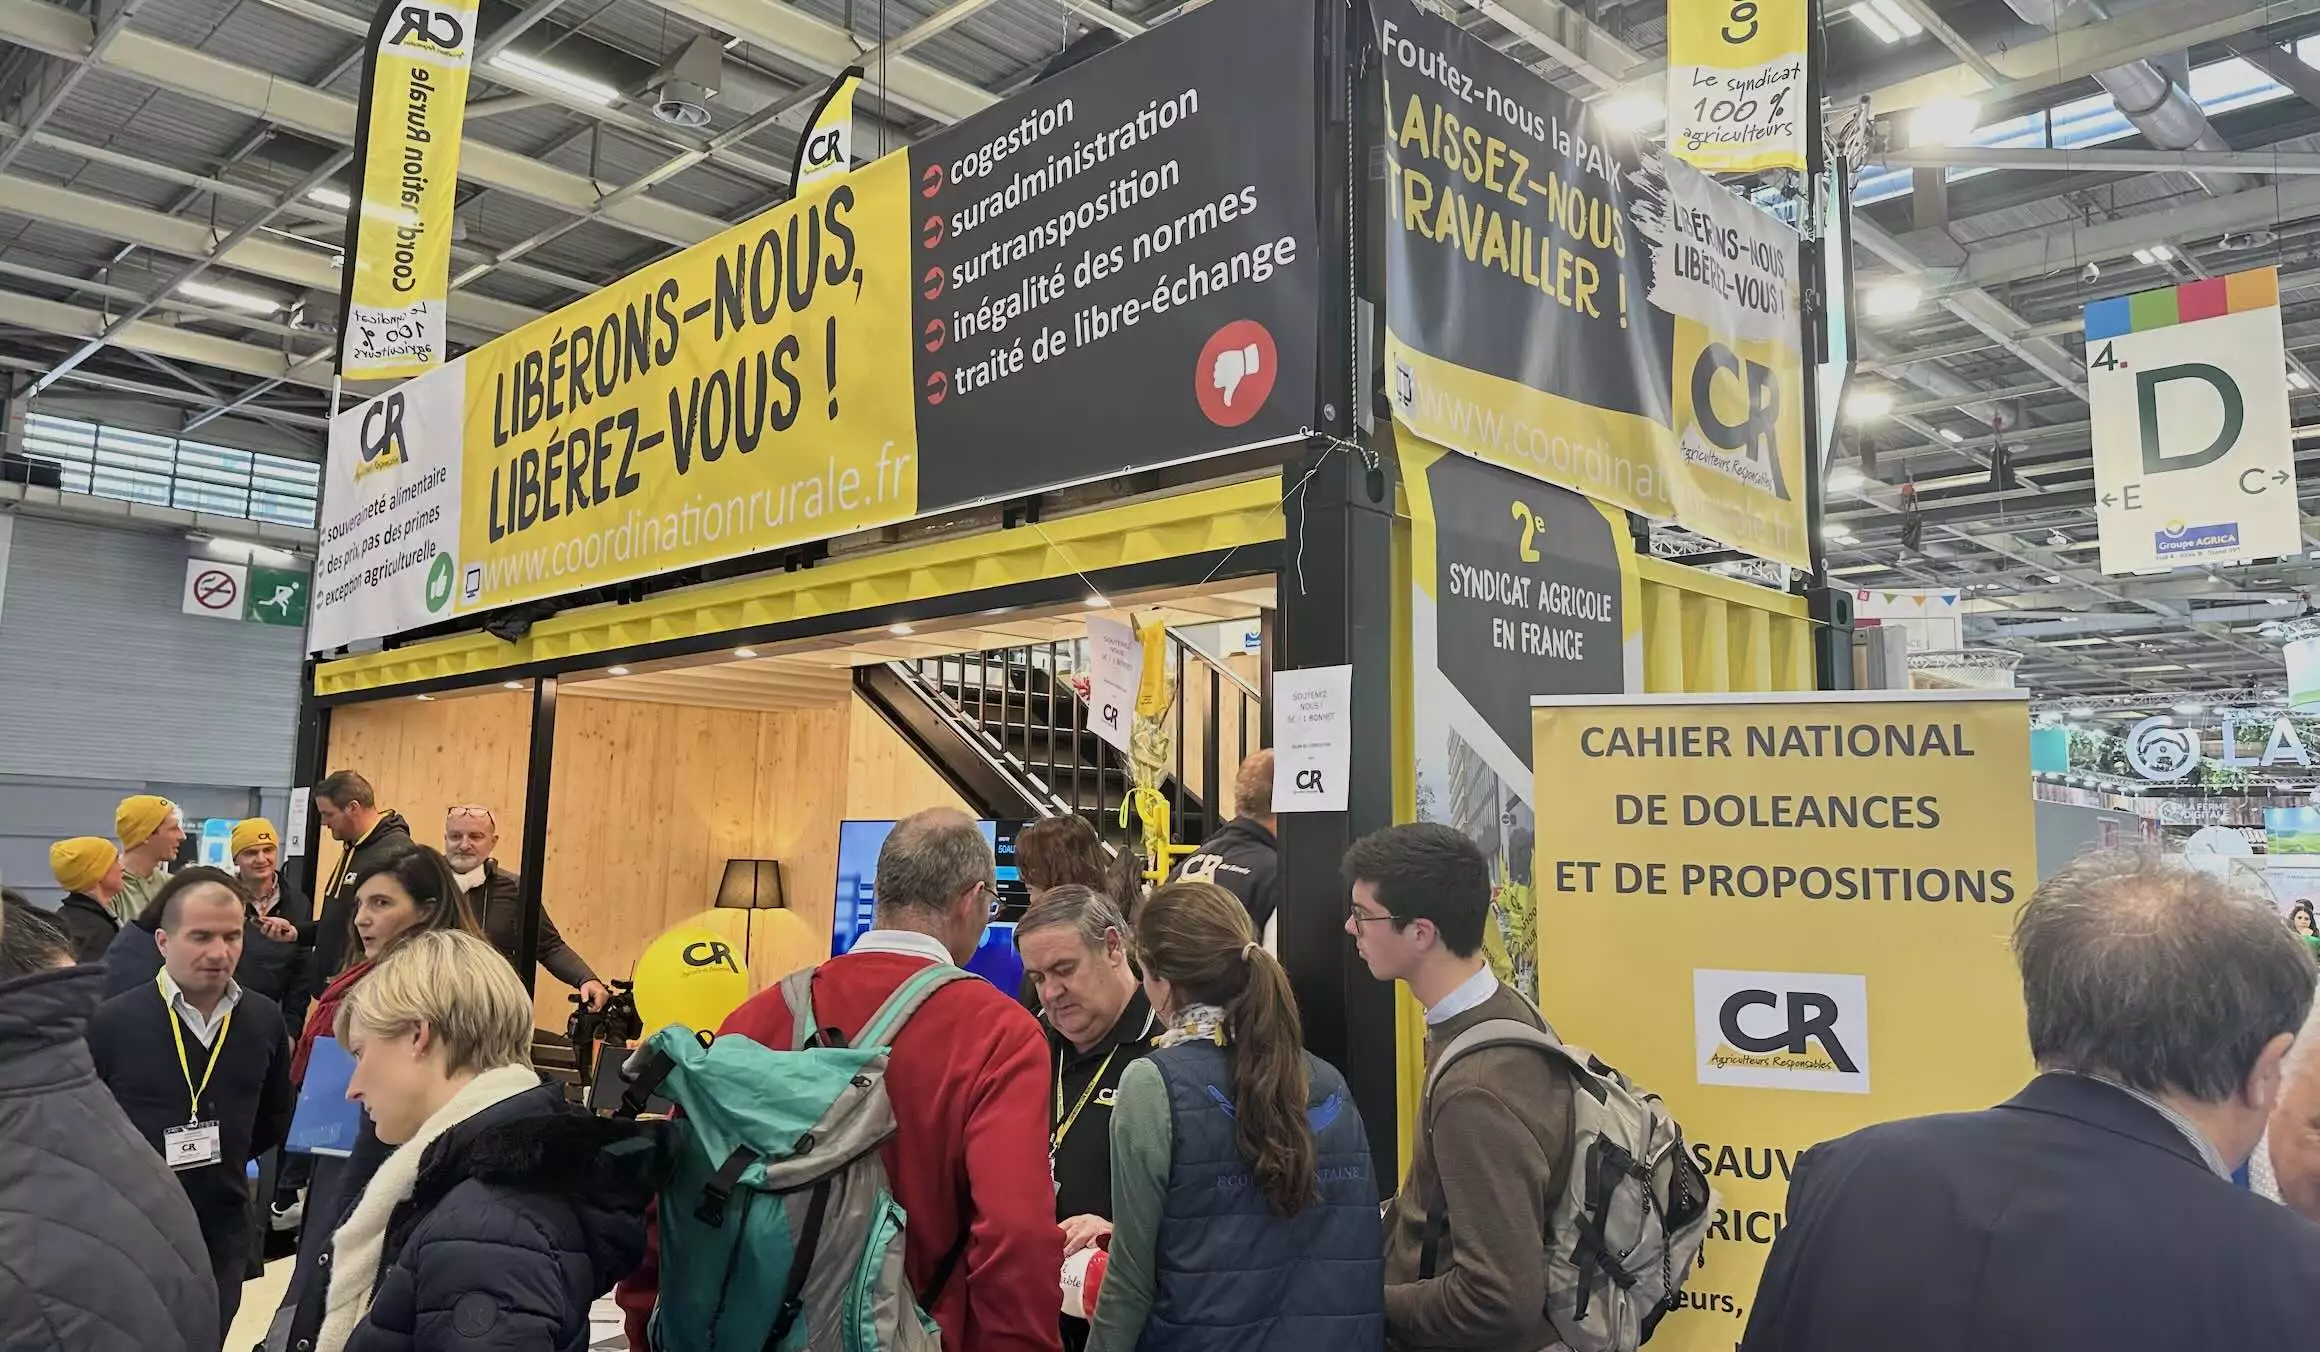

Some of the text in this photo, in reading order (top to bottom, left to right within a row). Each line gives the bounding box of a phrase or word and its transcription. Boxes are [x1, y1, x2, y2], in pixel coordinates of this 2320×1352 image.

[1382, 20, 1621, 193] Foutez-nous la PAIX
[1692, 61, 1801, 102] Le syndicat
[1694, 86, 1790, 124] 100 %
[808, 130, 844, 166] CR
[950, 98, 1074, 185] cogestion
[1683, 121, 1794, 151] agriculteurs
[951, 87, 1199, 238] suradministration
[1384, 79, 1627, 259] LAISSEZ-NOUS
[952, 159, 1180, 290] surtransposition
[1386, 150, 1628, 329] TRAVAILLER !
[953, 184, 1258, 343] inégalité des normes
[493, 184, 863, 448] LIBÉRONS-NOUS,
[954, 235, 1297, 395] traité de libre-échange
[361, 392, 409, 464] CR
[489, 316, 838, 544] LIBÉREZ-VOUS !
[1691, 342, 1792, 501] CR
[2136, 362, 2244, 475] D
[1680, 441, 1731, 473] Agriculteurs
[2239, 468, 2267, 495] C
[327, 494, 386, 543] souveraineté
[389, 466, 447, 510] alimentaire
[481, 440, 912, 592] www.coordinationrurale.fr
[2123, 485, 2143, 511] E
[327, 552, 343, 574] des
[361, 533, 380, 559] pas
[384, 523, 402, 545] des
[403, 505, 440, 540] primes
[2158, 534, 2237, 550] Groupe AGRICA
[325, 538, 436, 606] exception agriculturelle
[1449, 563, 1612, 622] SYNDICAT AGRICOLE
[1493, 617, 1584, 661] EN FRANCE
[1103, 704, 1118, 731] CR
[1581, 723, 1976, 758] CAHIER NATIONAL
[1296, 770, 1325, 793] CR
[1615, 793, 1941, 830] DE DOLEANCES
[1555, 860, 2016, 904] ET DE PROPOSITIONS
[683, 941, 740, 974] CR
[1718, 989, 1861, 1074] CR
[1711, 1053, 1832, 1071] Agriculteurs Responsables
[182, 1143, 197, 1152] CR
[1692, 1144, 1804, 1181] SAUV
[1677, 1290, 1743, 1319] eurs,
